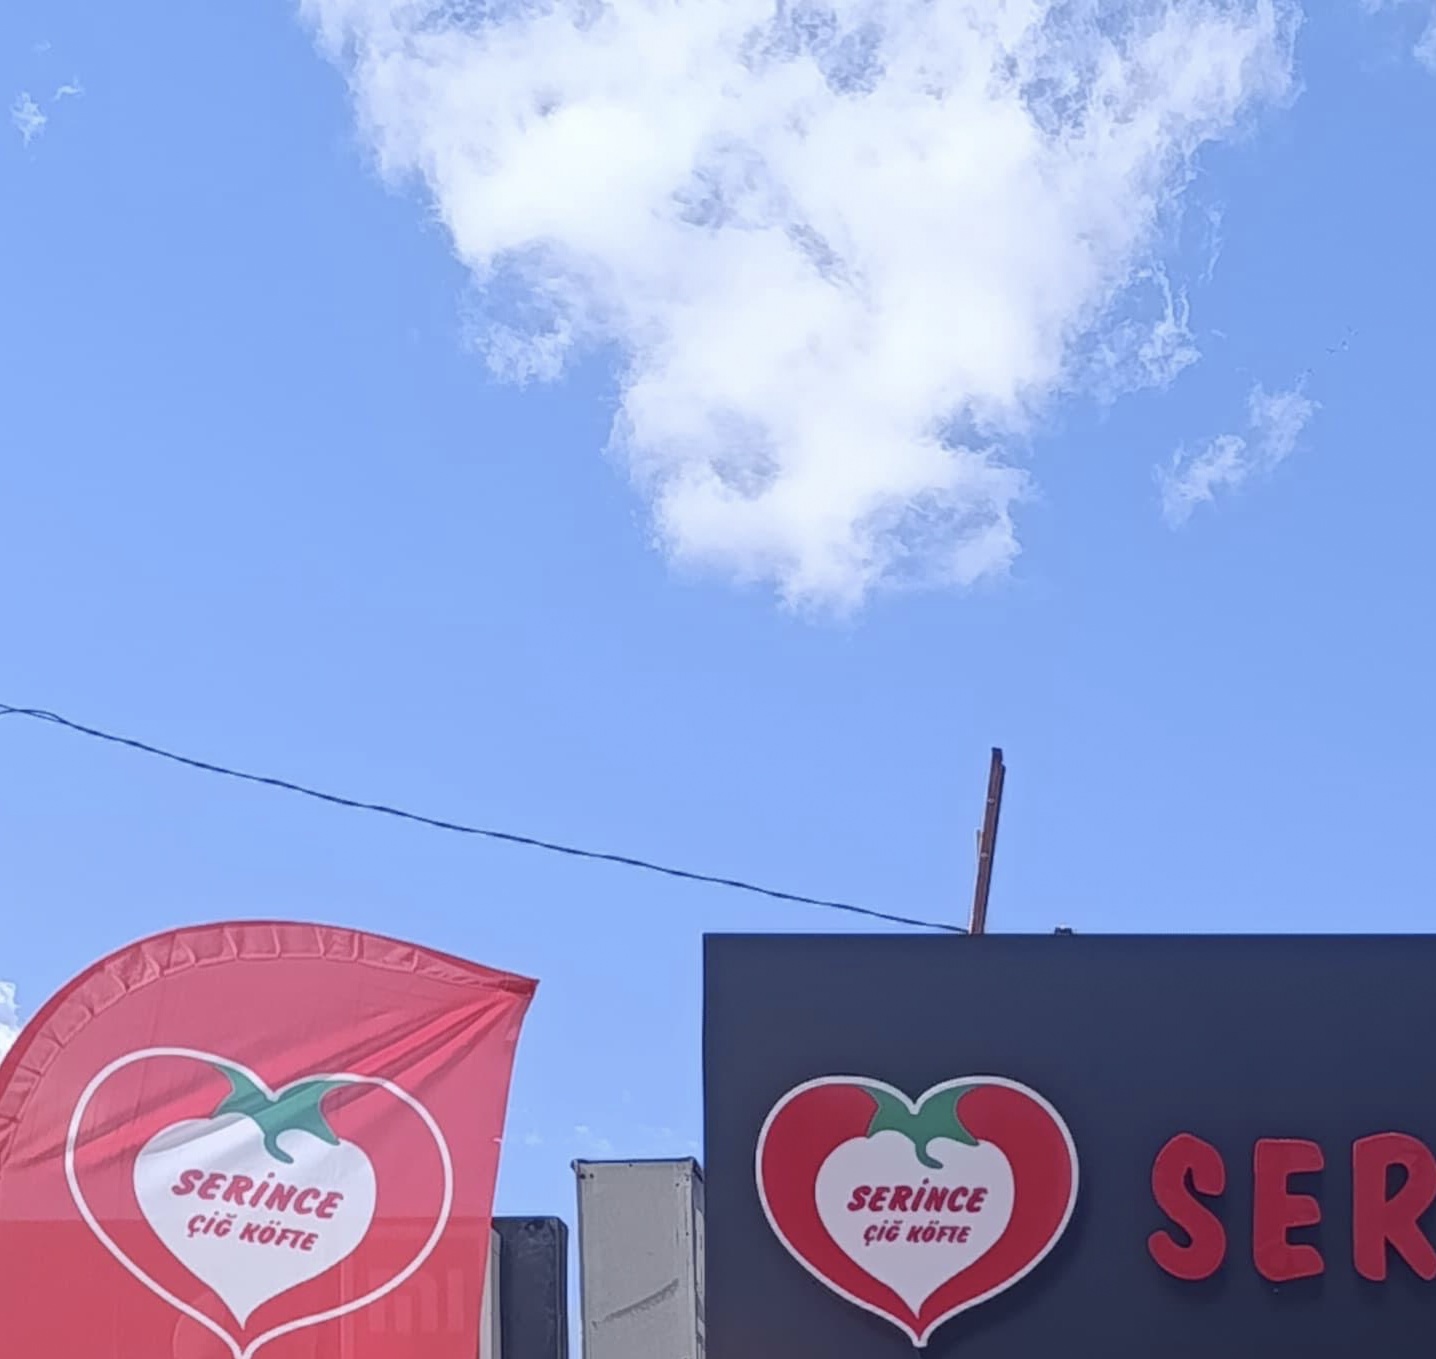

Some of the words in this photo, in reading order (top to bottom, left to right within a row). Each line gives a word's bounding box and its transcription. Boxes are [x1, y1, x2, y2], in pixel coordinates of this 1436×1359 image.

[171, 1170, 344, 1219] SERİNCE
[847, 1177, 988, 1213] SERİNCE
[188, 1211, 237, 1238] ÇİĞ
[239, 1220, 318, 1250] KÖFTE
[863, 1220, 903, 1246] ÇİĞ
[906, 1220, 971, 1243] KÖFTE
